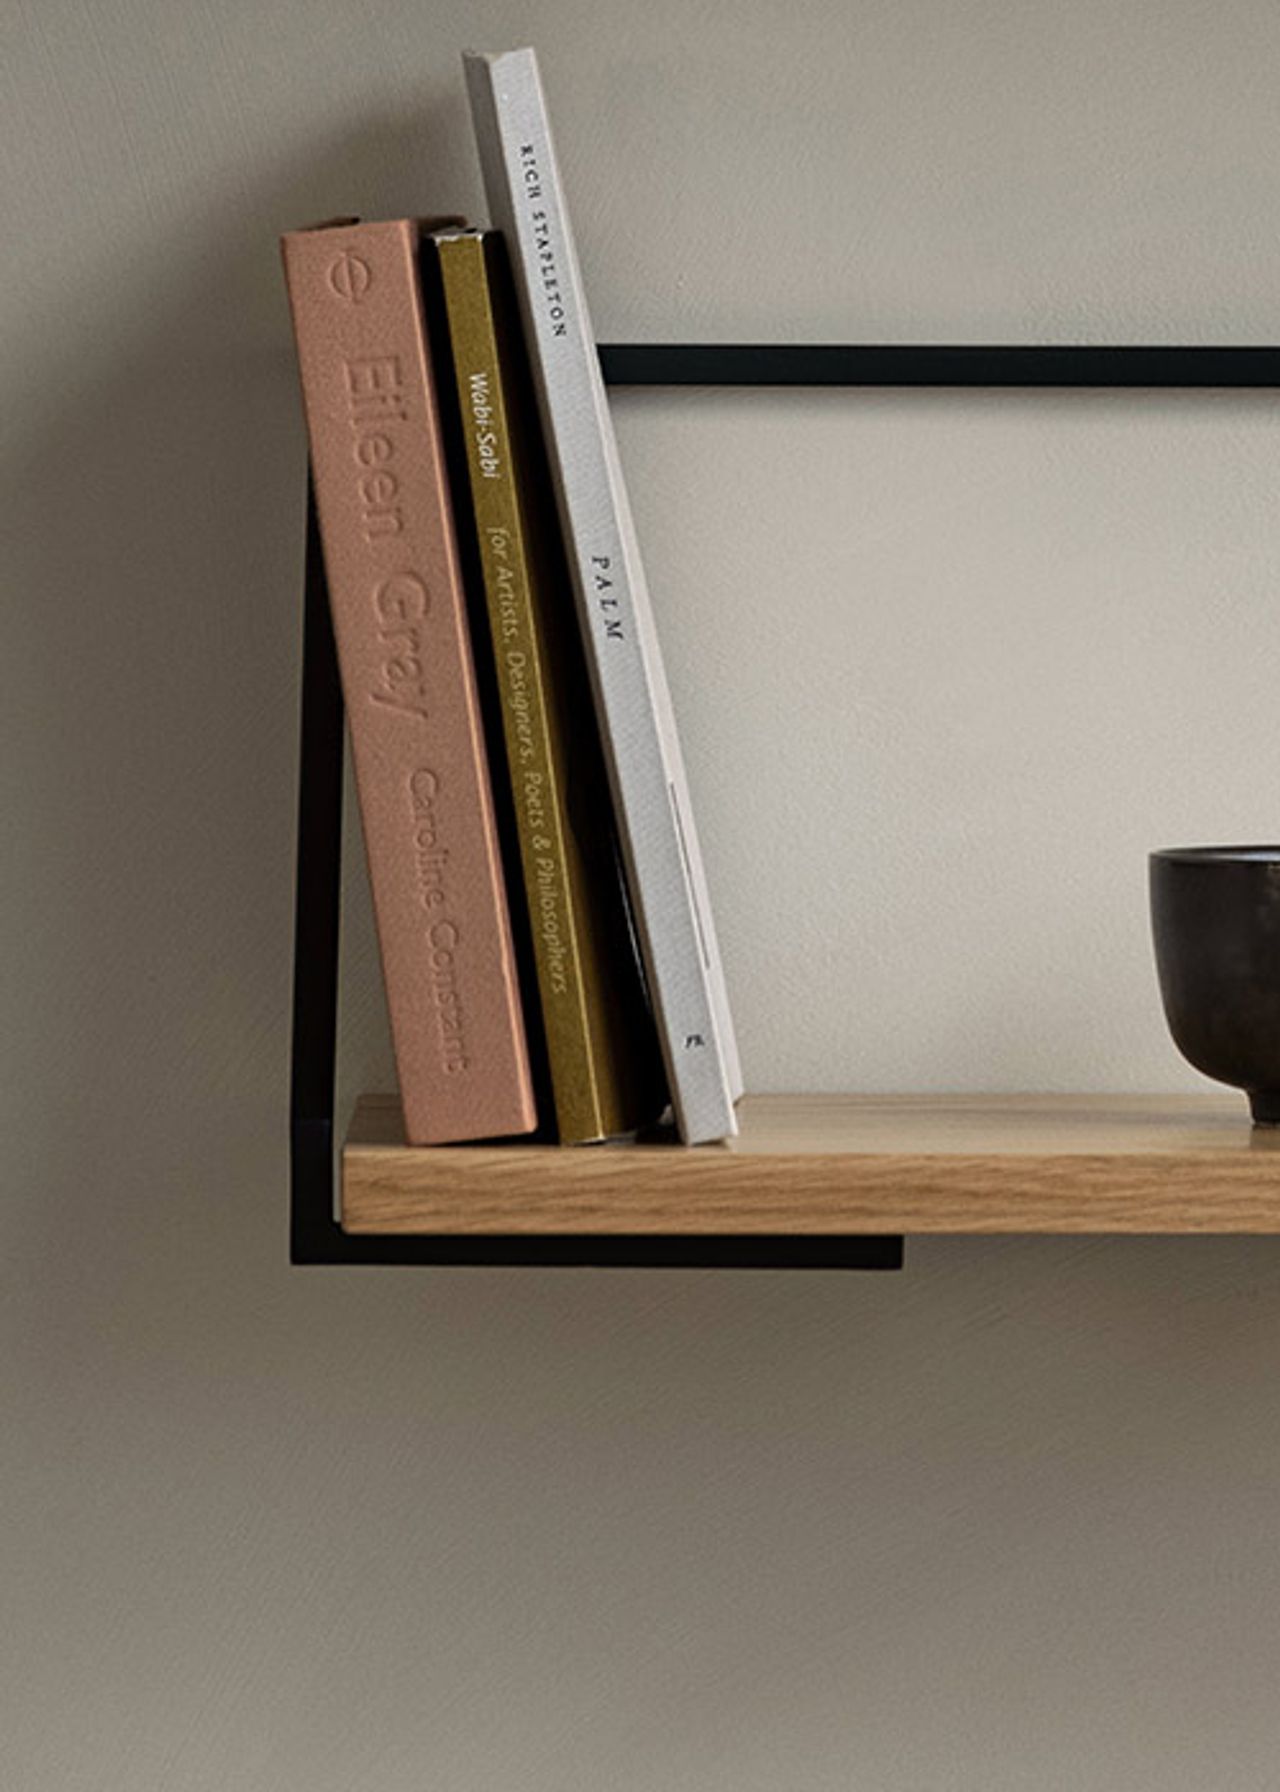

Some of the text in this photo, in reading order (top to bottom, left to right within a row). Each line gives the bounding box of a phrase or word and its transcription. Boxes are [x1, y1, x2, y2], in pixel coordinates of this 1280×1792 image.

[520, 144, 567, 338] RICH STAPLETON
[469, 373, 501, 479] Wabi-Sabi
[342, 354, 431, 721] Eileen Gray
[486, 526, 509, 560] for
[592, 555, 624, 640] PALM
[524, 771, 546, 828] Poets
[532, 834, 552, 851] &
[410, 767, 470, 1074] Caroline Constant
[535, 857, 569, 994] Philosophers
